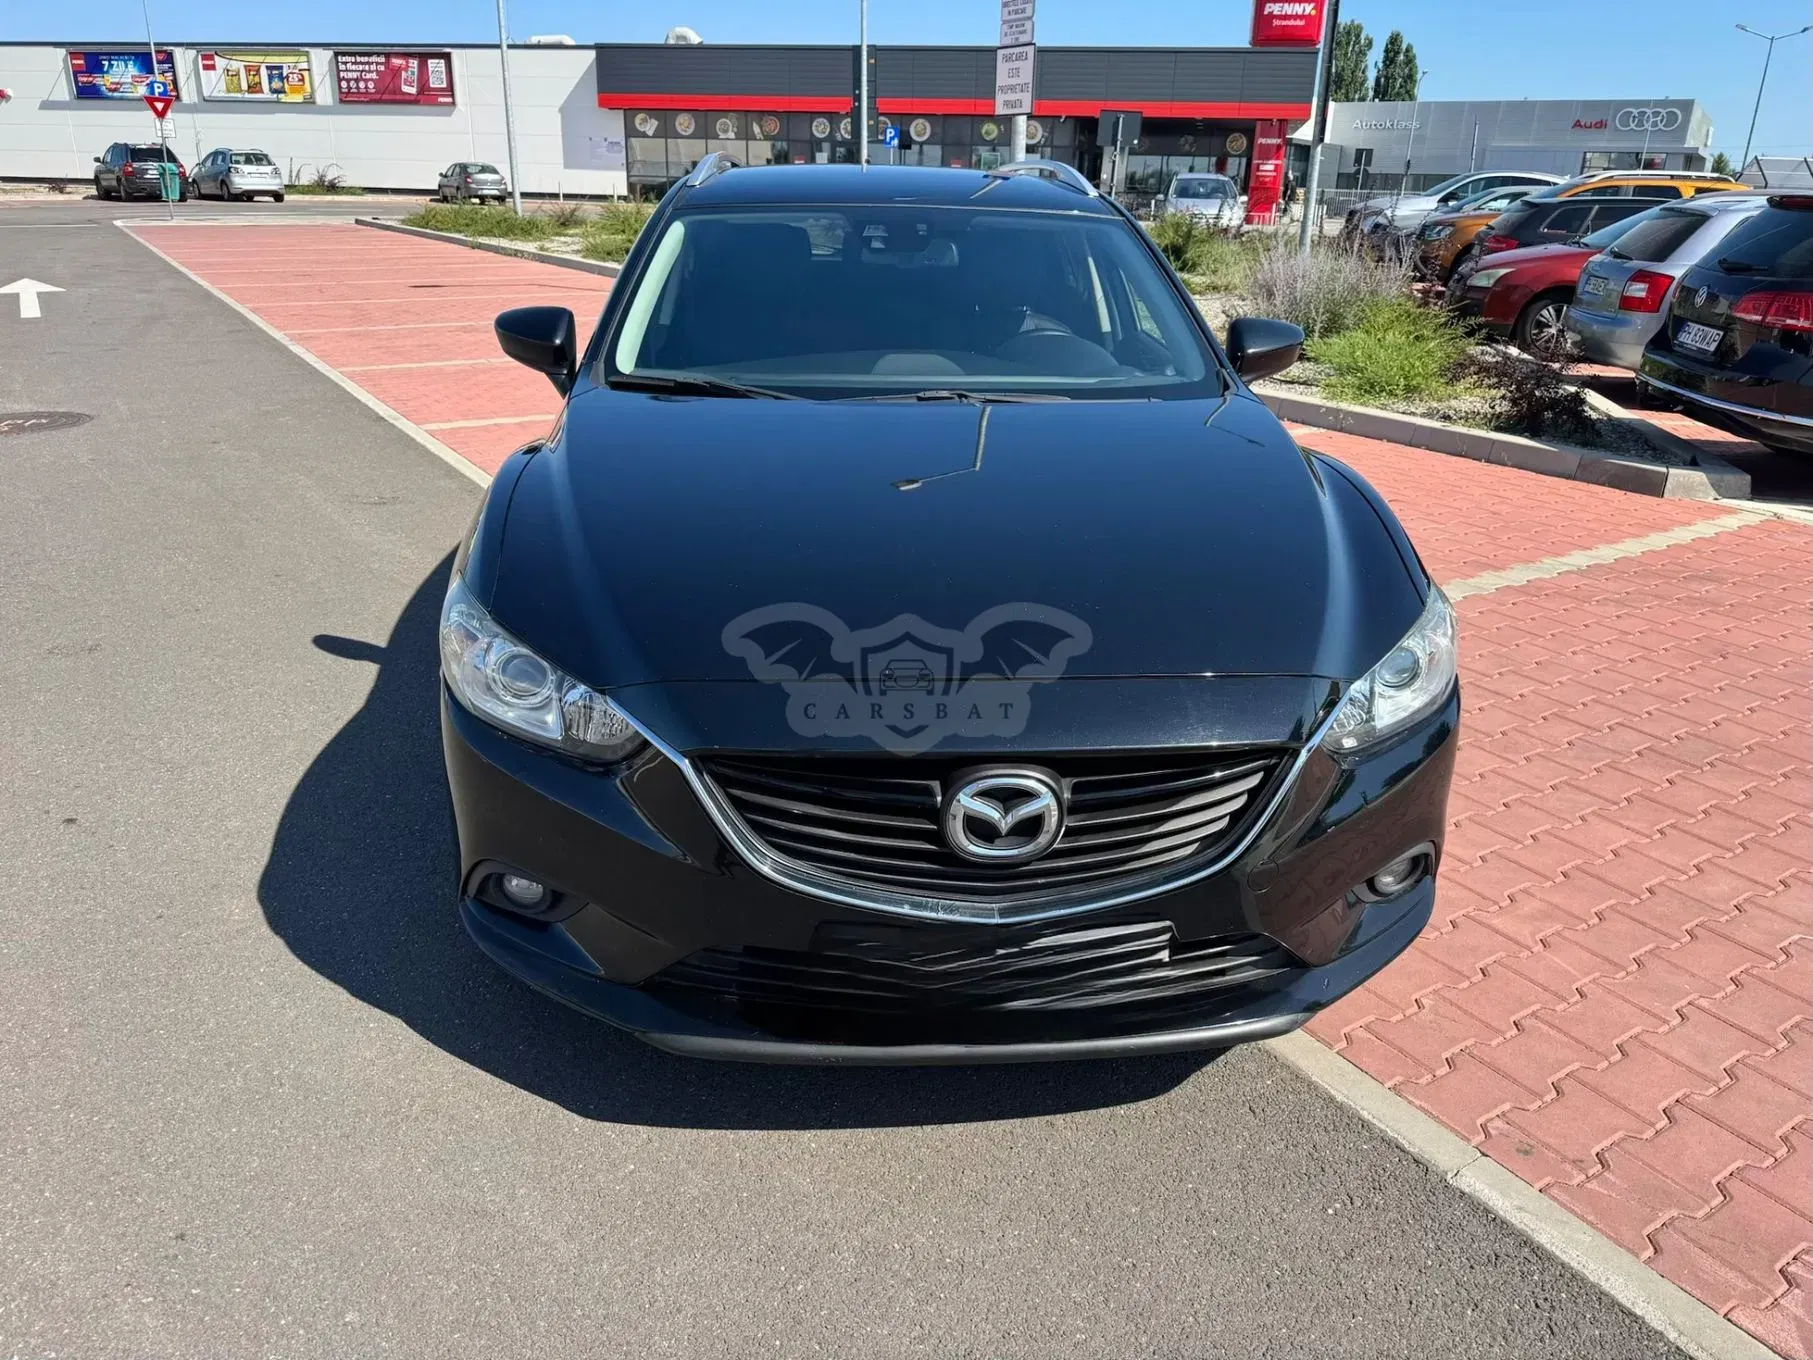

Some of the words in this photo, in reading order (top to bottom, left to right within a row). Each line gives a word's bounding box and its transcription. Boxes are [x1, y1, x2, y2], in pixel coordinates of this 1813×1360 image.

[1002, 51, 1029, 64] PARCAREA
[1007, 67, 1021, 79] ESTE
[154, 82, 164, 97] P
[997, 82, 1031, 95] PROPRIETATE
[1002, 99, 1023, 110] PRIVATA
[1352, 119, 1421, 130] Autoklass
[1571, 118, 1608, 130] Audi
[886, 128, 895, 143] P
